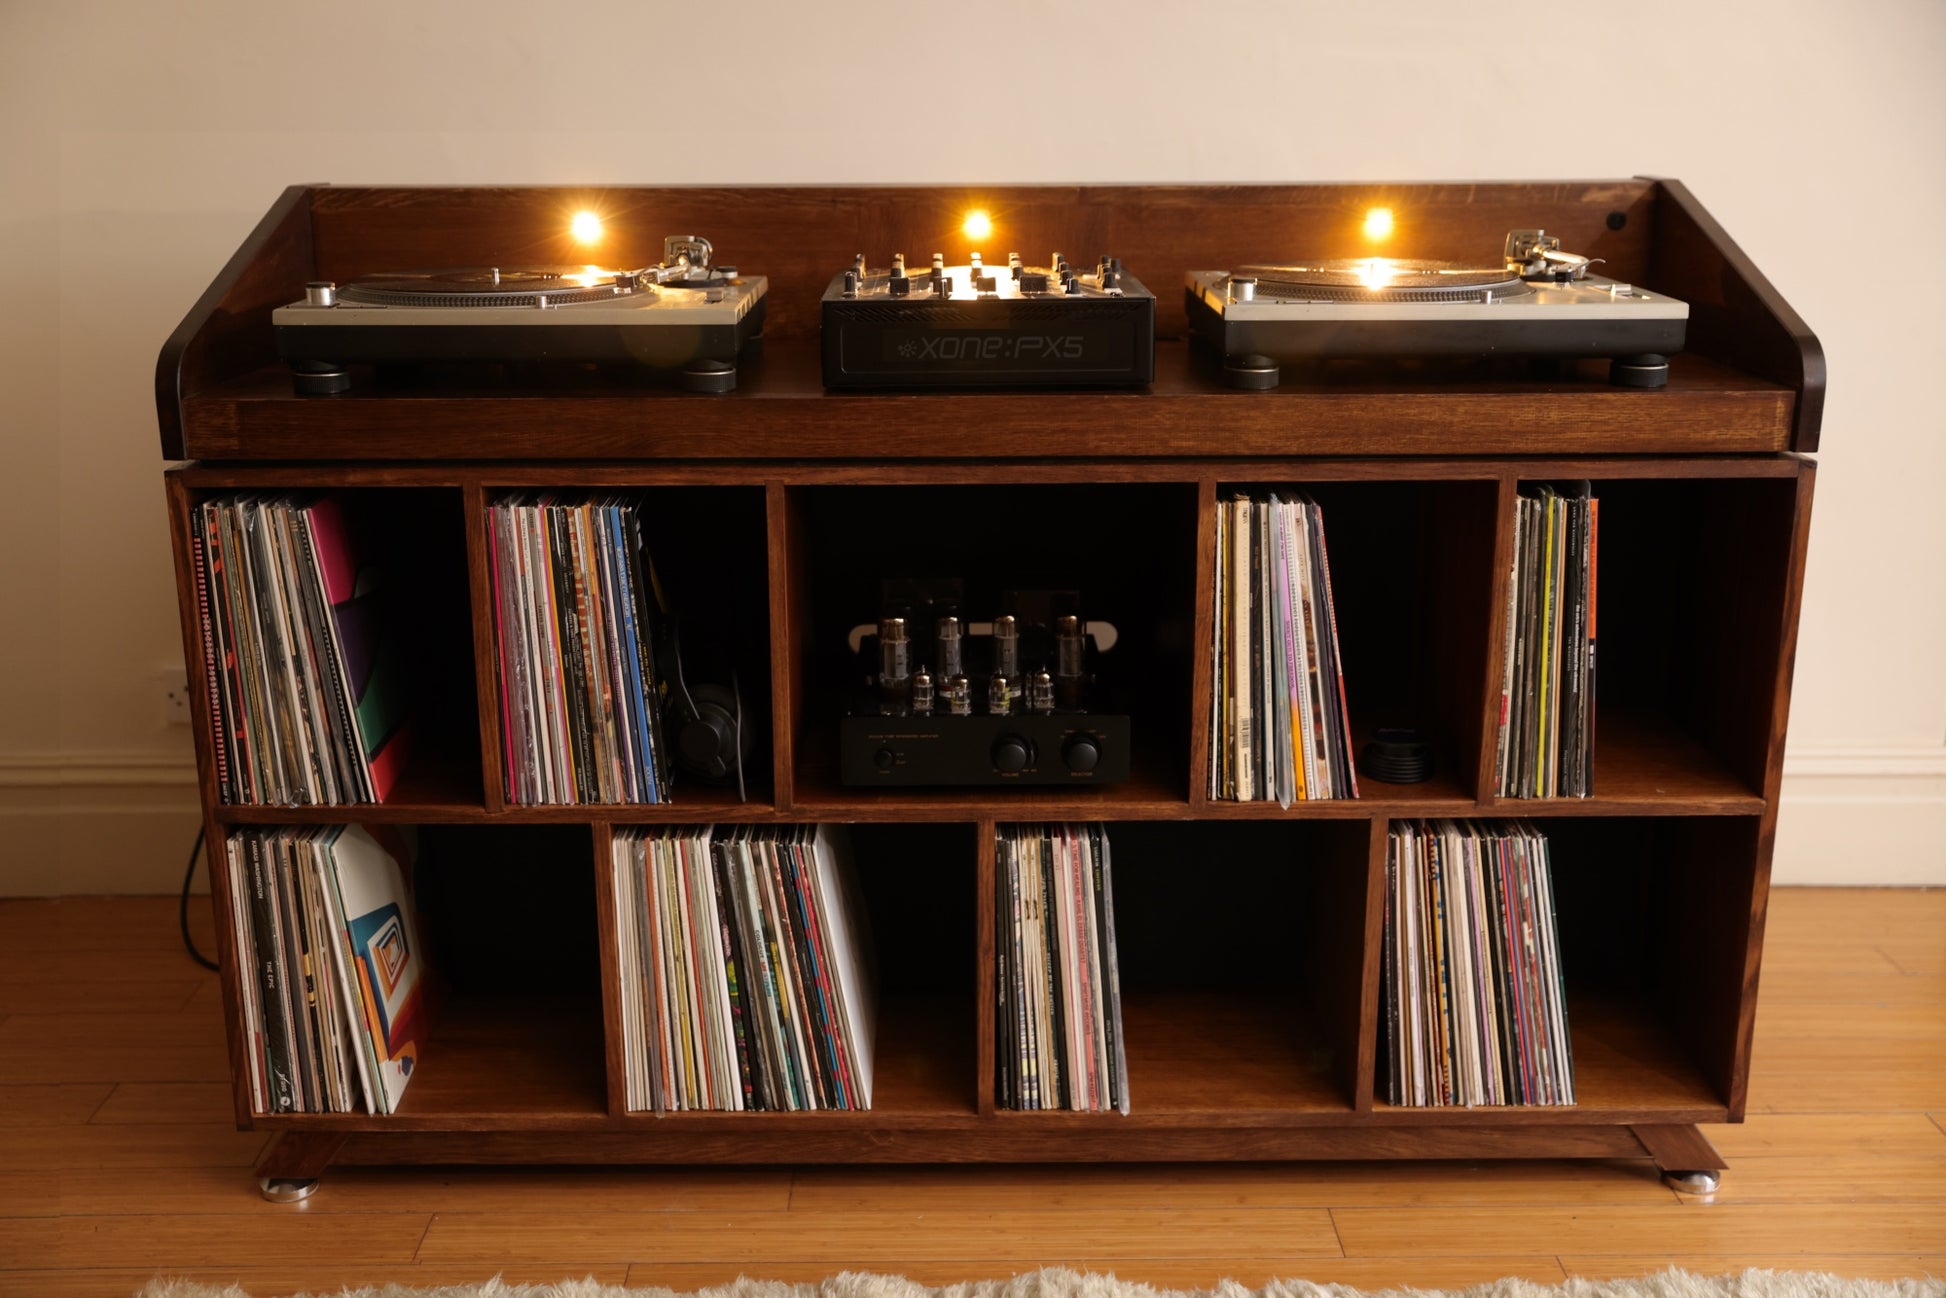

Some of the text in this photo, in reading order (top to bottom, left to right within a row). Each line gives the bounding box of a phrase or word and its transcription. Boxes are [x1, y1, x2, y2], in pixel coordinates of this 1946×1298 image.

[253, 862, 263, 899] WASHINGTON
[754, 929, 765, 958] COLDCUT
[264, 960, 275, 989] THE EPIC
